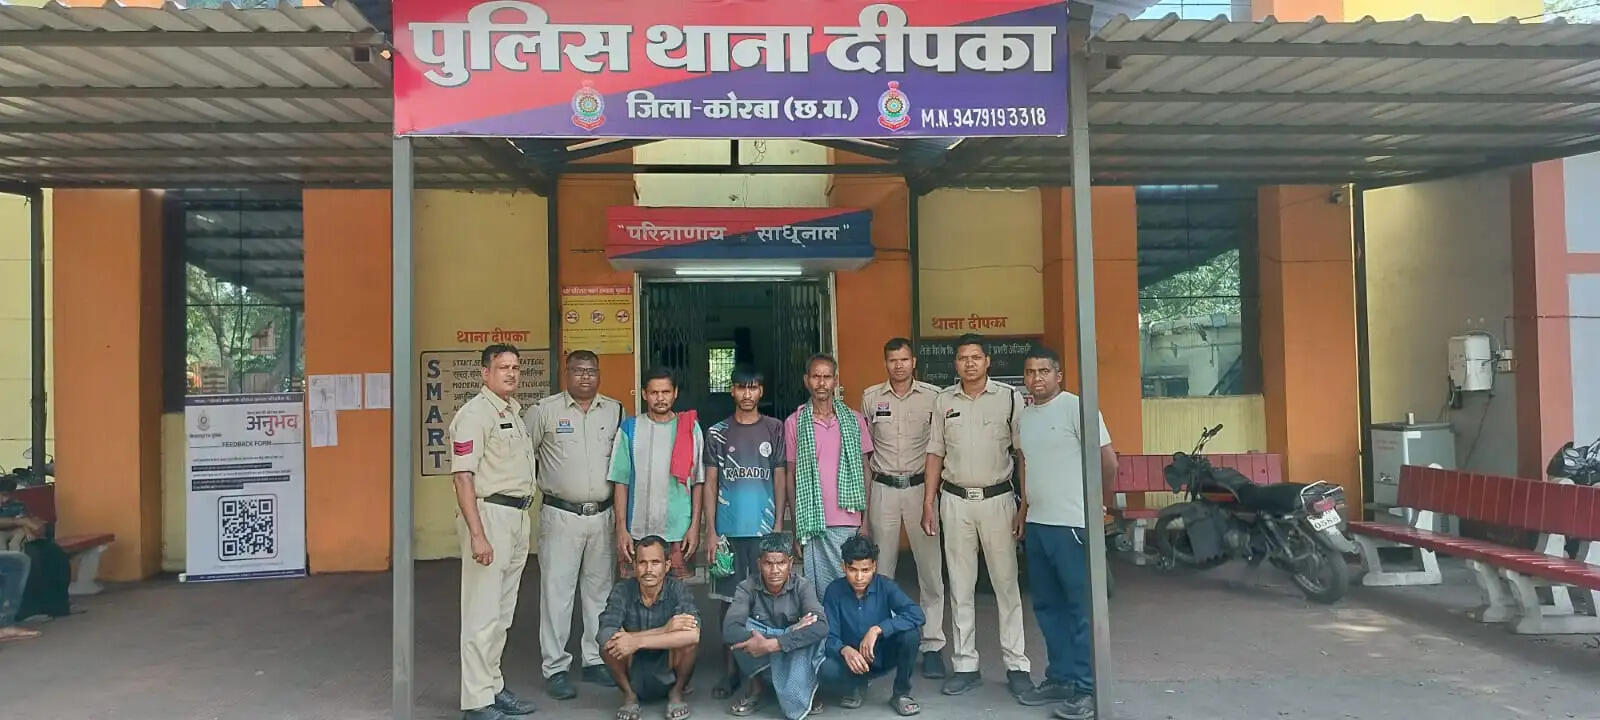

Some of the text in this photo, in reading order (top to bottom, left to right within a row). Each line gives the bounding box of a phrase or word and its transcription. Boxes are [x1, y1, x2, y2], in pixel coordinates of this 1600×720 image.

[408, 1, 1057, 86] पुलिस थाना दीपका
[783, 96, 859, 121] (छ.ग.)
[931, 314, 1008, 331] थाना दीपका
[456, 327, 531, 344] थाना दीपका
[246, 414, 299, 436] अनुभव
[222, 440, 253, 448] FEEDBACK
[724, 466, 771, 481] KABADDI
